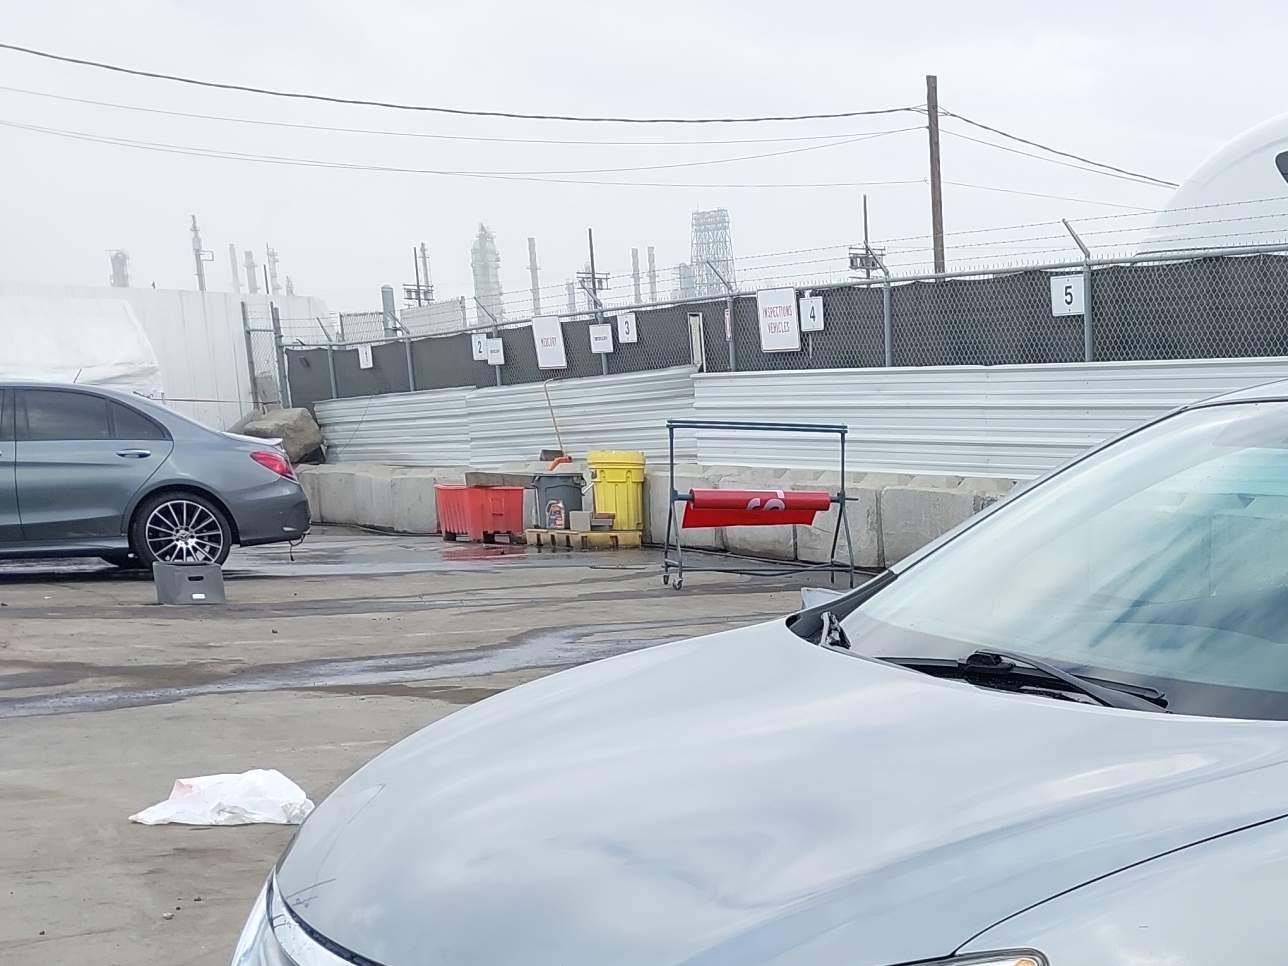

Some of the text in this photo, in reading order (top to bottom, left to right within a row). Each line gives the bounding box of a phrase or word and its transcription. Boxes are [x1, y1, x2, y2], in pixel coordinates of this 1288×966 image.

[1064, 285, 1073, 305] 5
[762, 305, 793, 319] INSPECTIONS
[809, 305, 816, 322] 4
[624, 320, 631, 335] 3
[767, 321, 790, 334] VEHICLES
[477, 340, 483, 353] 2
